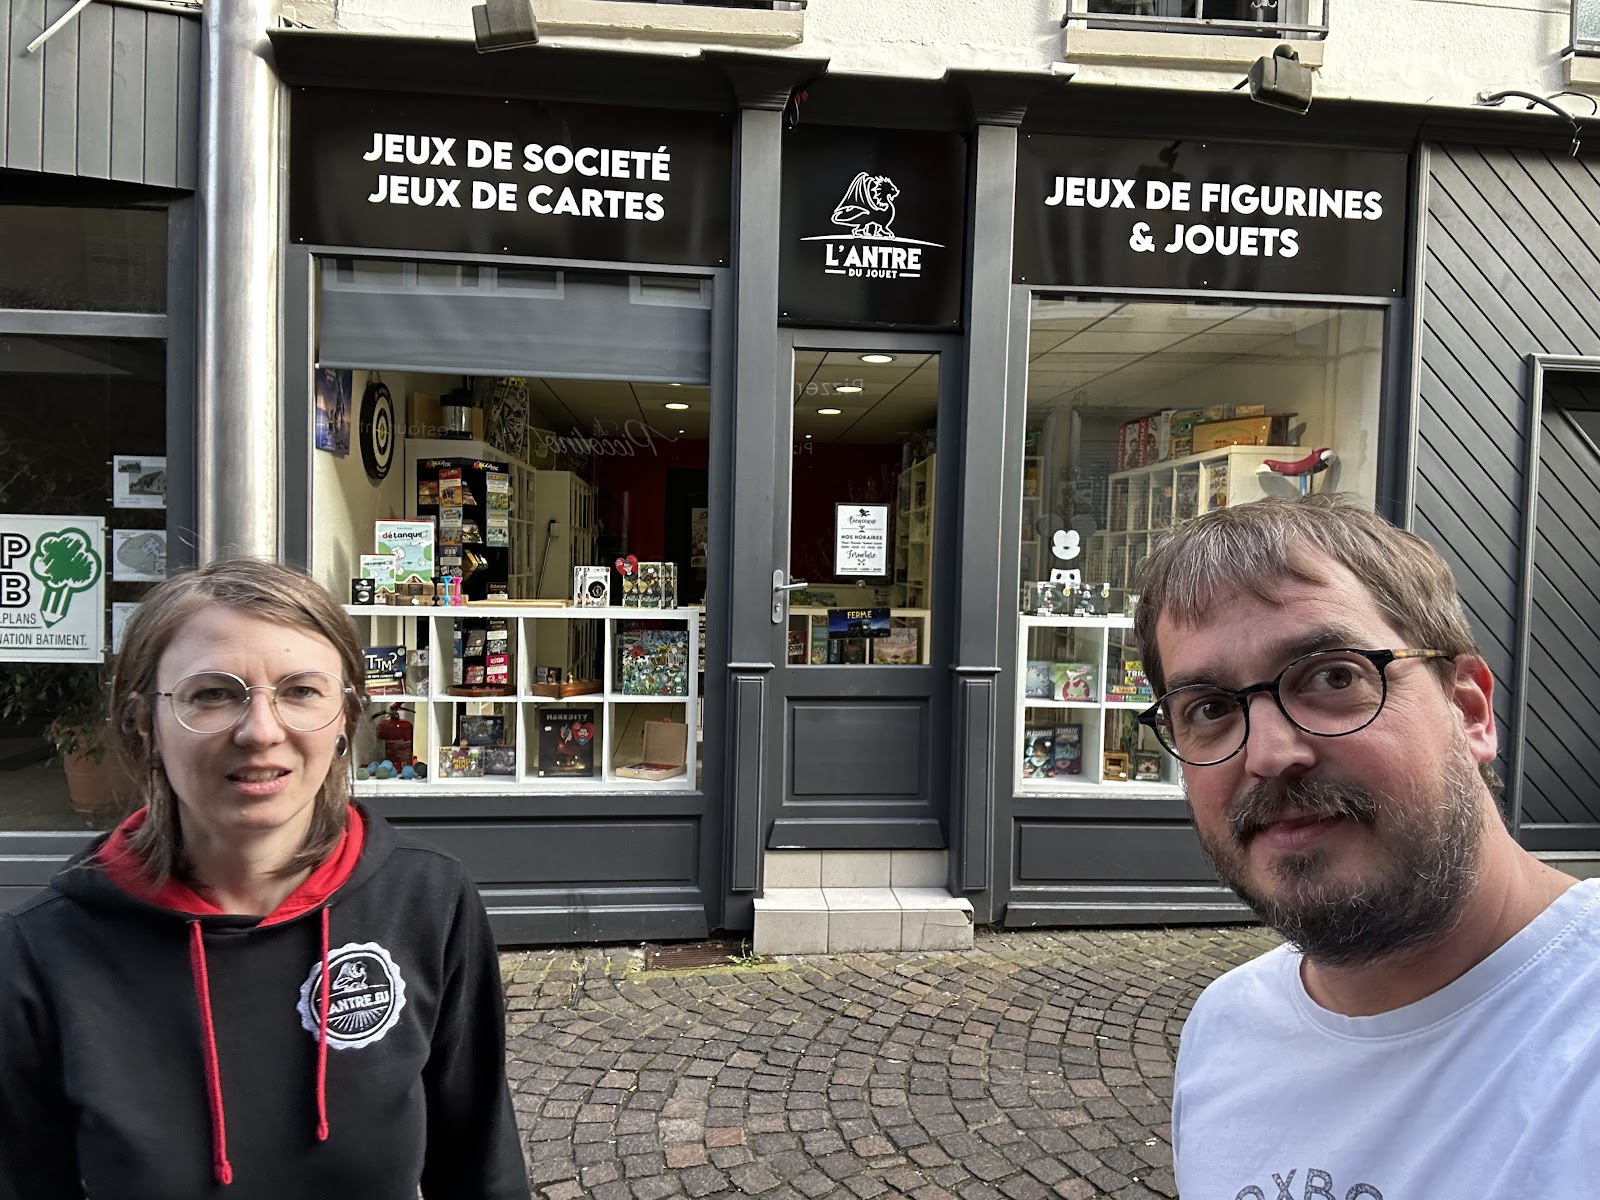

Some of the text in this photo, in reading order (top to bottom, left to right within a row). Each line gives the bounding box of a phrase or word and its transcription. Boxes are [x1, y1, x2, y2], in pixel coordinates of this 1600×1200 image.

[363, 132, 671, 182] JEUX DE SOCIETÉ
[368, 174, 665, 222] JEUX DE CARTES
[1044, 176, 1383, 221] JEUX DE FIGURINES
[1129, 221, 1299, 258] & JOUETS
[848, 268, 898, 279] DU JOUET
[321, 990, 390, 1016] ANTRE.EU
